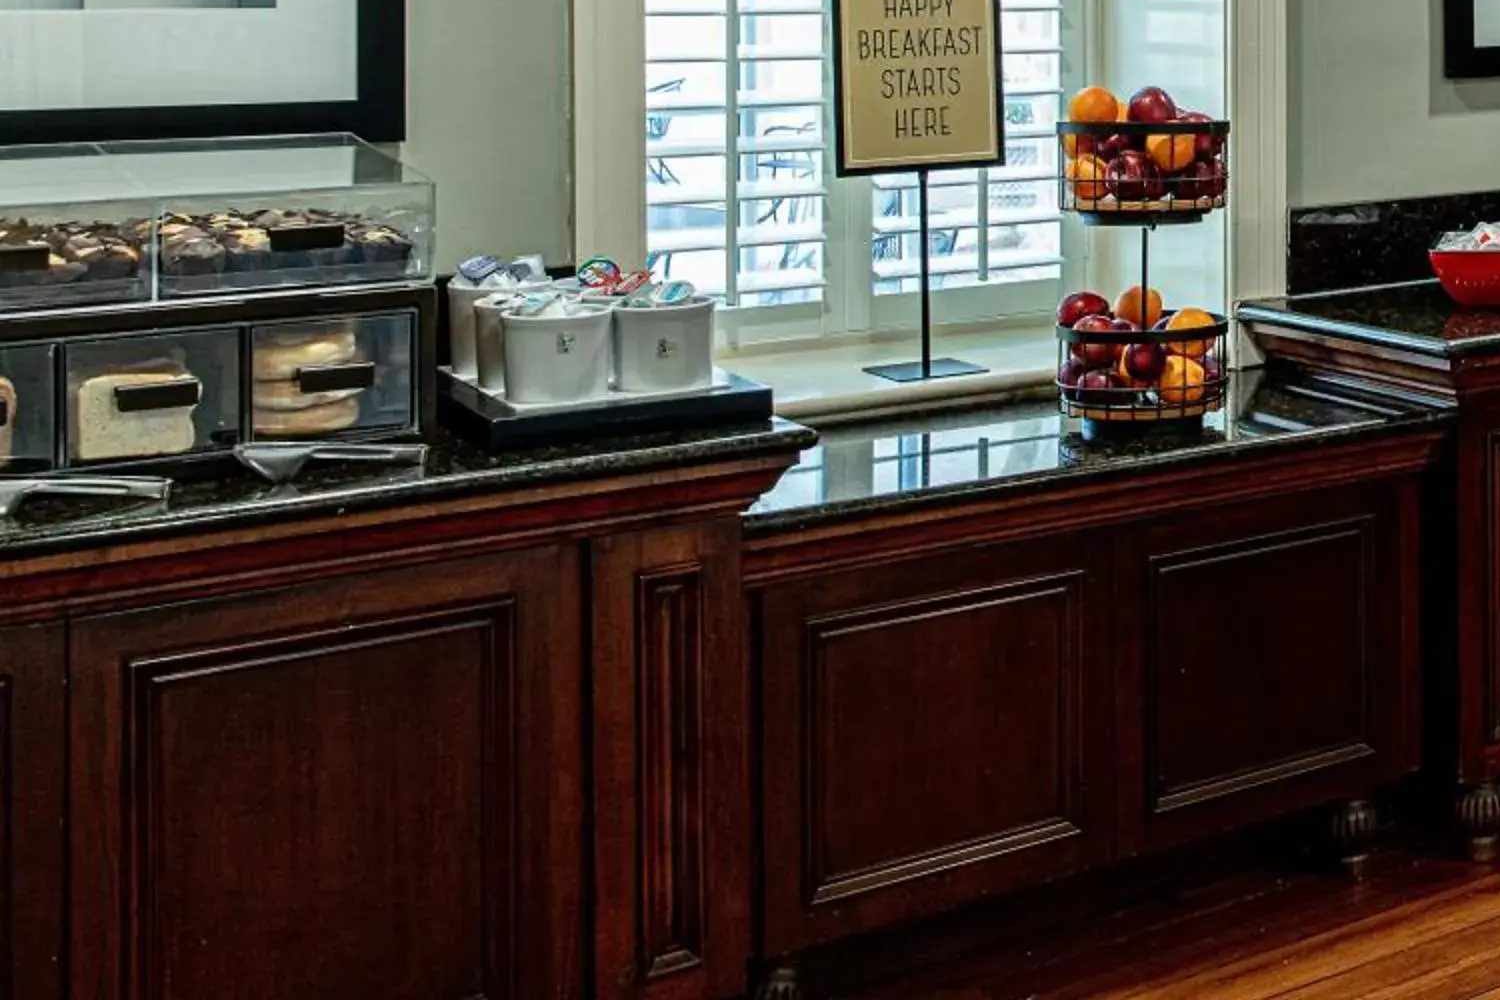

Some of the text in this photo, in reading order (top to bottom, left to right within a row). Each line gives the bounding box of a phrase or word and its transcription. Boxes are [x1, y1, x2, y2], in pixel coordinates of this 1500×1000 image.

[857, 26, 983, 60] BREAKFAST
[881, 66, 961, 99] STARTS
[895, 106, 953, 139] HERE
